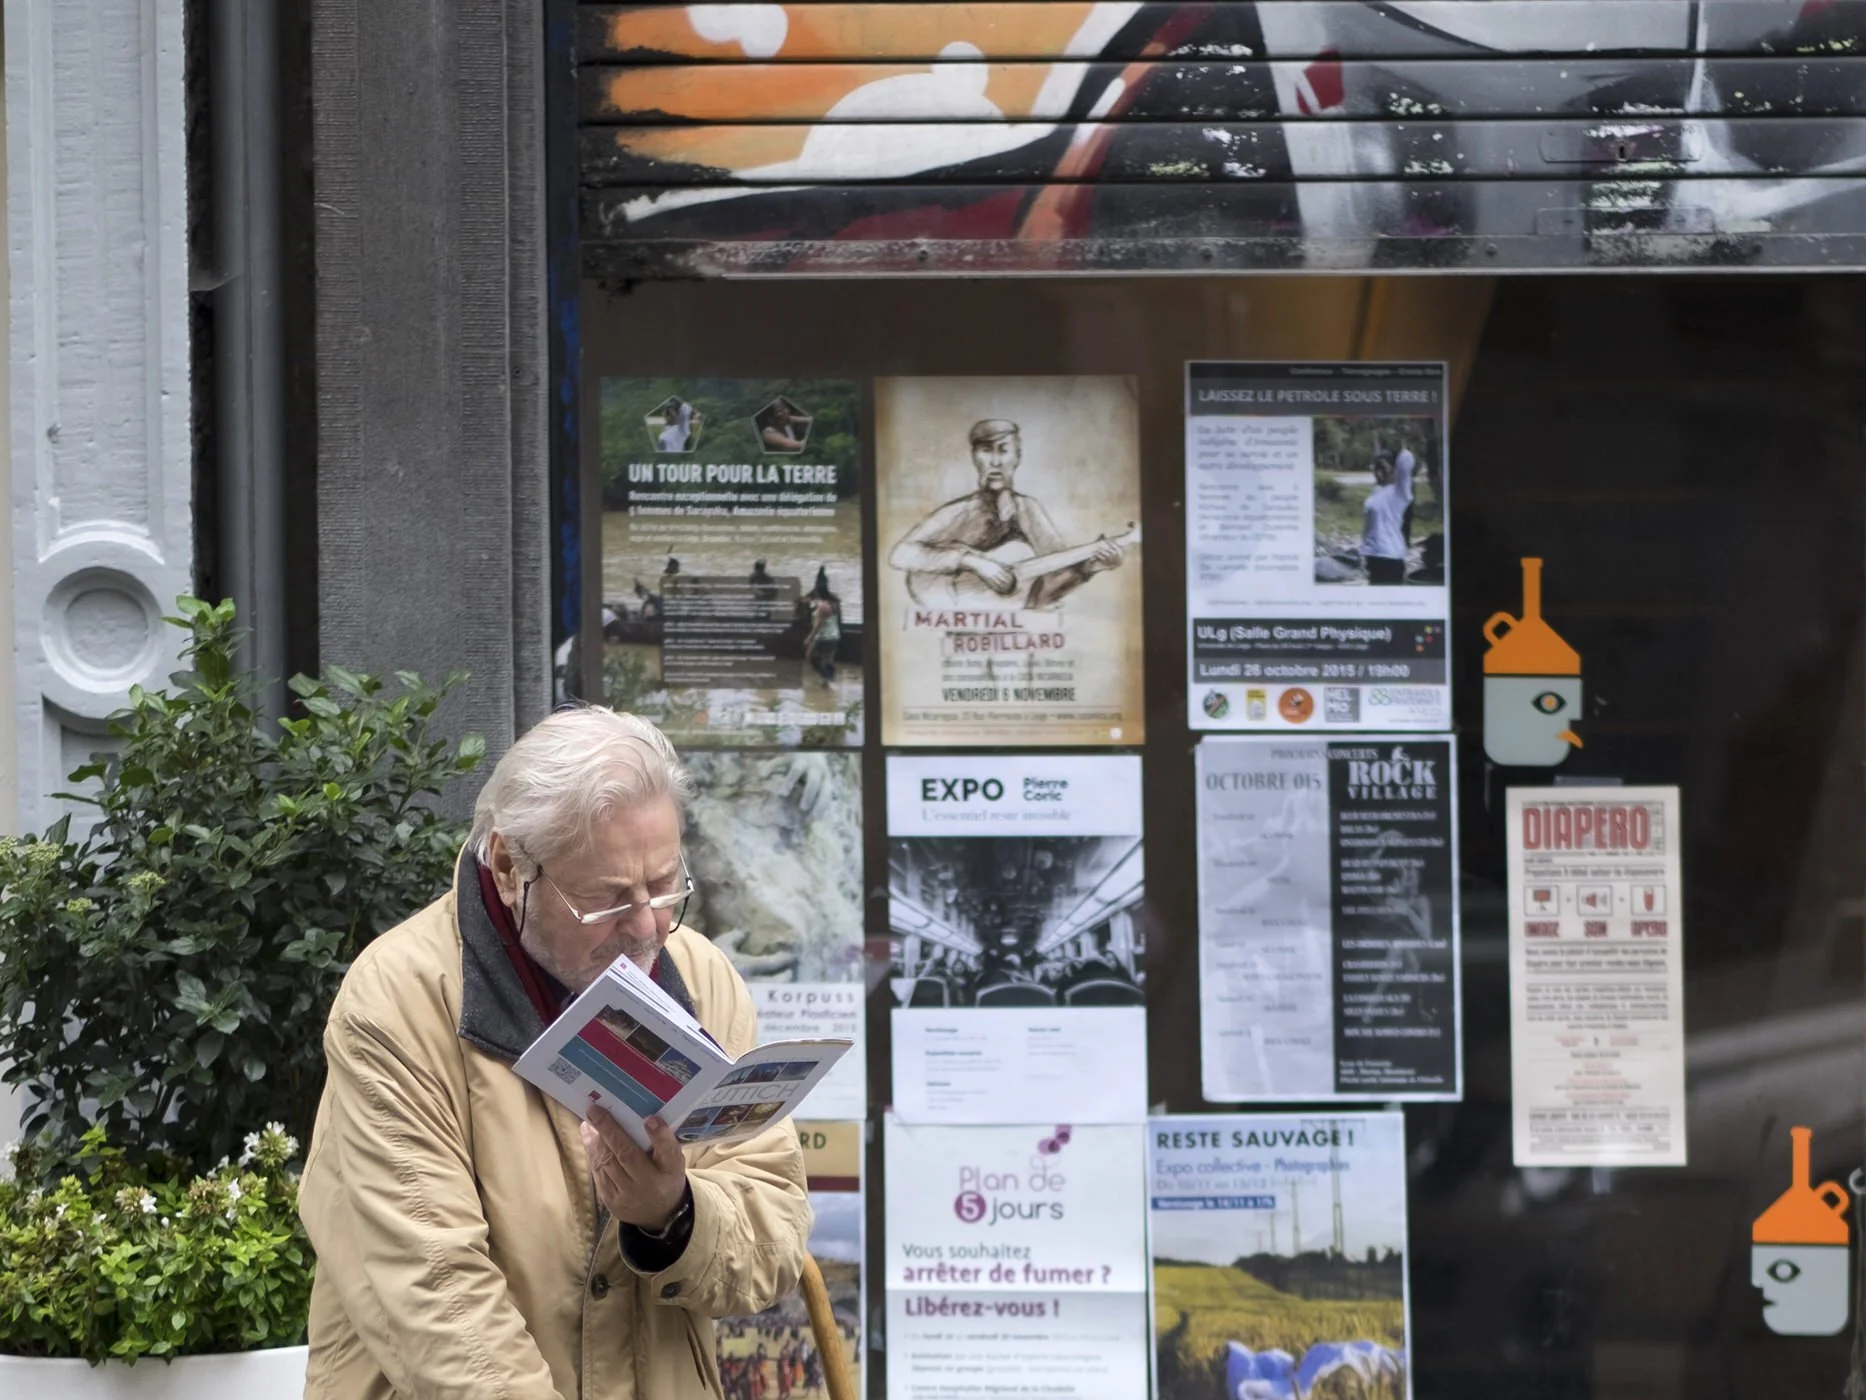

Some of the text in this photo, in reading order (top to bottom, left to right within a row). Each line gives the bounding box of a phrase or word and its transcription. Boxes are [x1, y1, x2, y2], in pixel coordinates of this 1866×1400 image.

[1198, 389, 1254, 402] LAISSEZ
[1257, 390, 1274, 402] LE
[1277, 390, 1339, 402] PETROLE
[1342, 390, 1383, 402] SOUS
[1386, 390, 1428, 402] TERRE
[628, 464, 838, 484] UN TOUR POUR LA TERRE
[914, 611, 1024, 629] MARTIAL
[953, 633, 1066, 653] ROBILLARD
[1197, 625, 1392, 644] ULg (Salle Grand Physique)
[1200, 664, 1241, 677] Lundi
[1264, 664, 1319, 677] octobre
[1321, 664, 1356, 677] 2015
[942, 687, 998, 702] VENDREDI
[1013, 687, 1077, 702] NOVEMBRE
[1205, 773, 1291, 791] OCTOBRE
[1348, 760, 1437, 786] ROCK
[921, 778, 1005, 801] EXPO
[1023, 777, 1069, 789] Pierre
[1347, 786, 1438, 799] VILLAGE
[1522, 805, 1650, 850] DIAPERO
[767, 989, 855, 1005] Korpuss
[757, 1009, 796, 1019] éateur
[763, 1023, 820, 1033] décembre
[800, 1132, 827, 1149] RD
[1156, 1130, 1355, 1149] RESTE SAUVAGE !
[1156, 1159, 1193, 1177] Expo
[1197, 1157, 1262, 1174] collective
[958, 1165, 1066, 1192] Plan de
[988, 1197, 1064, 1226] jours
[901, 1243, 1031, 1259] Vous souhaitez
[903, 1262, 1112, 1284] arrêter de fumer ?
[905, 1298, 1060, 1317] Libérez-vous !
